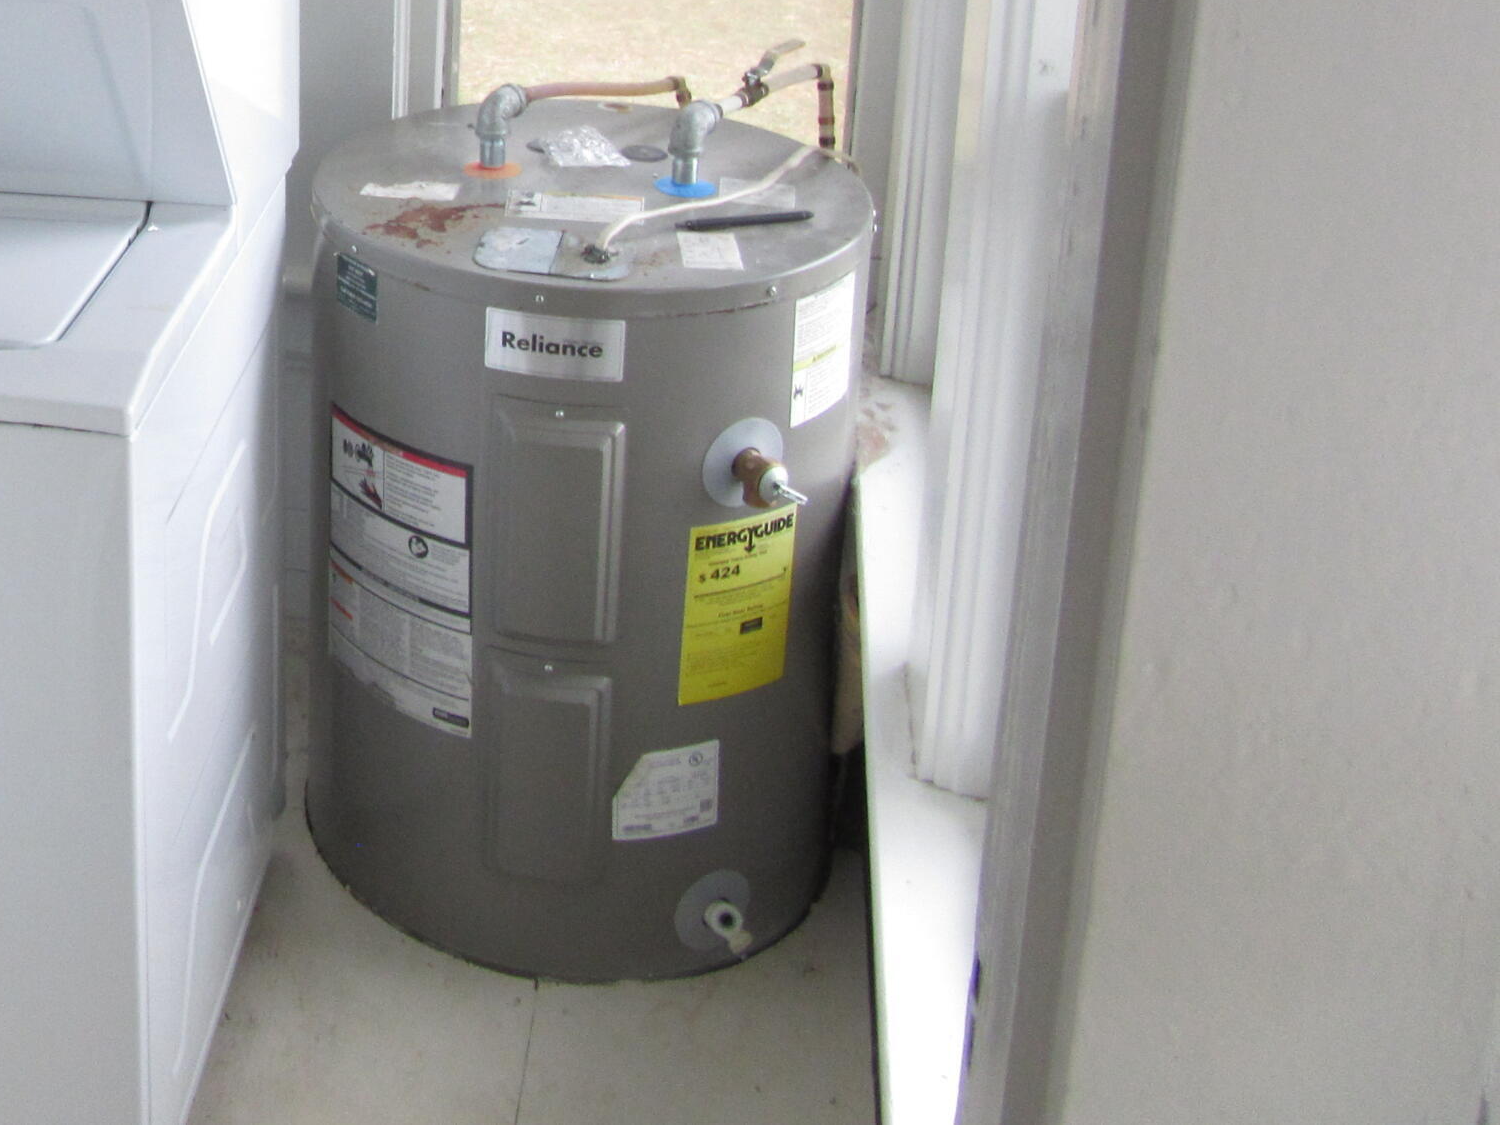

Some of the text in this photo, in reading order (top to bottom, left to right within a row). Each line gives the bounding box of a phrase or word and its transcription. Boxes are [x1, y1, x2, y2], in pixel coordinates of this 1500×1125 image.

[501, 331, 604, 358] Reliance
[694, 513, 794, 552] ENERGYGUIDE
[710, 564, 741, 581] 424
